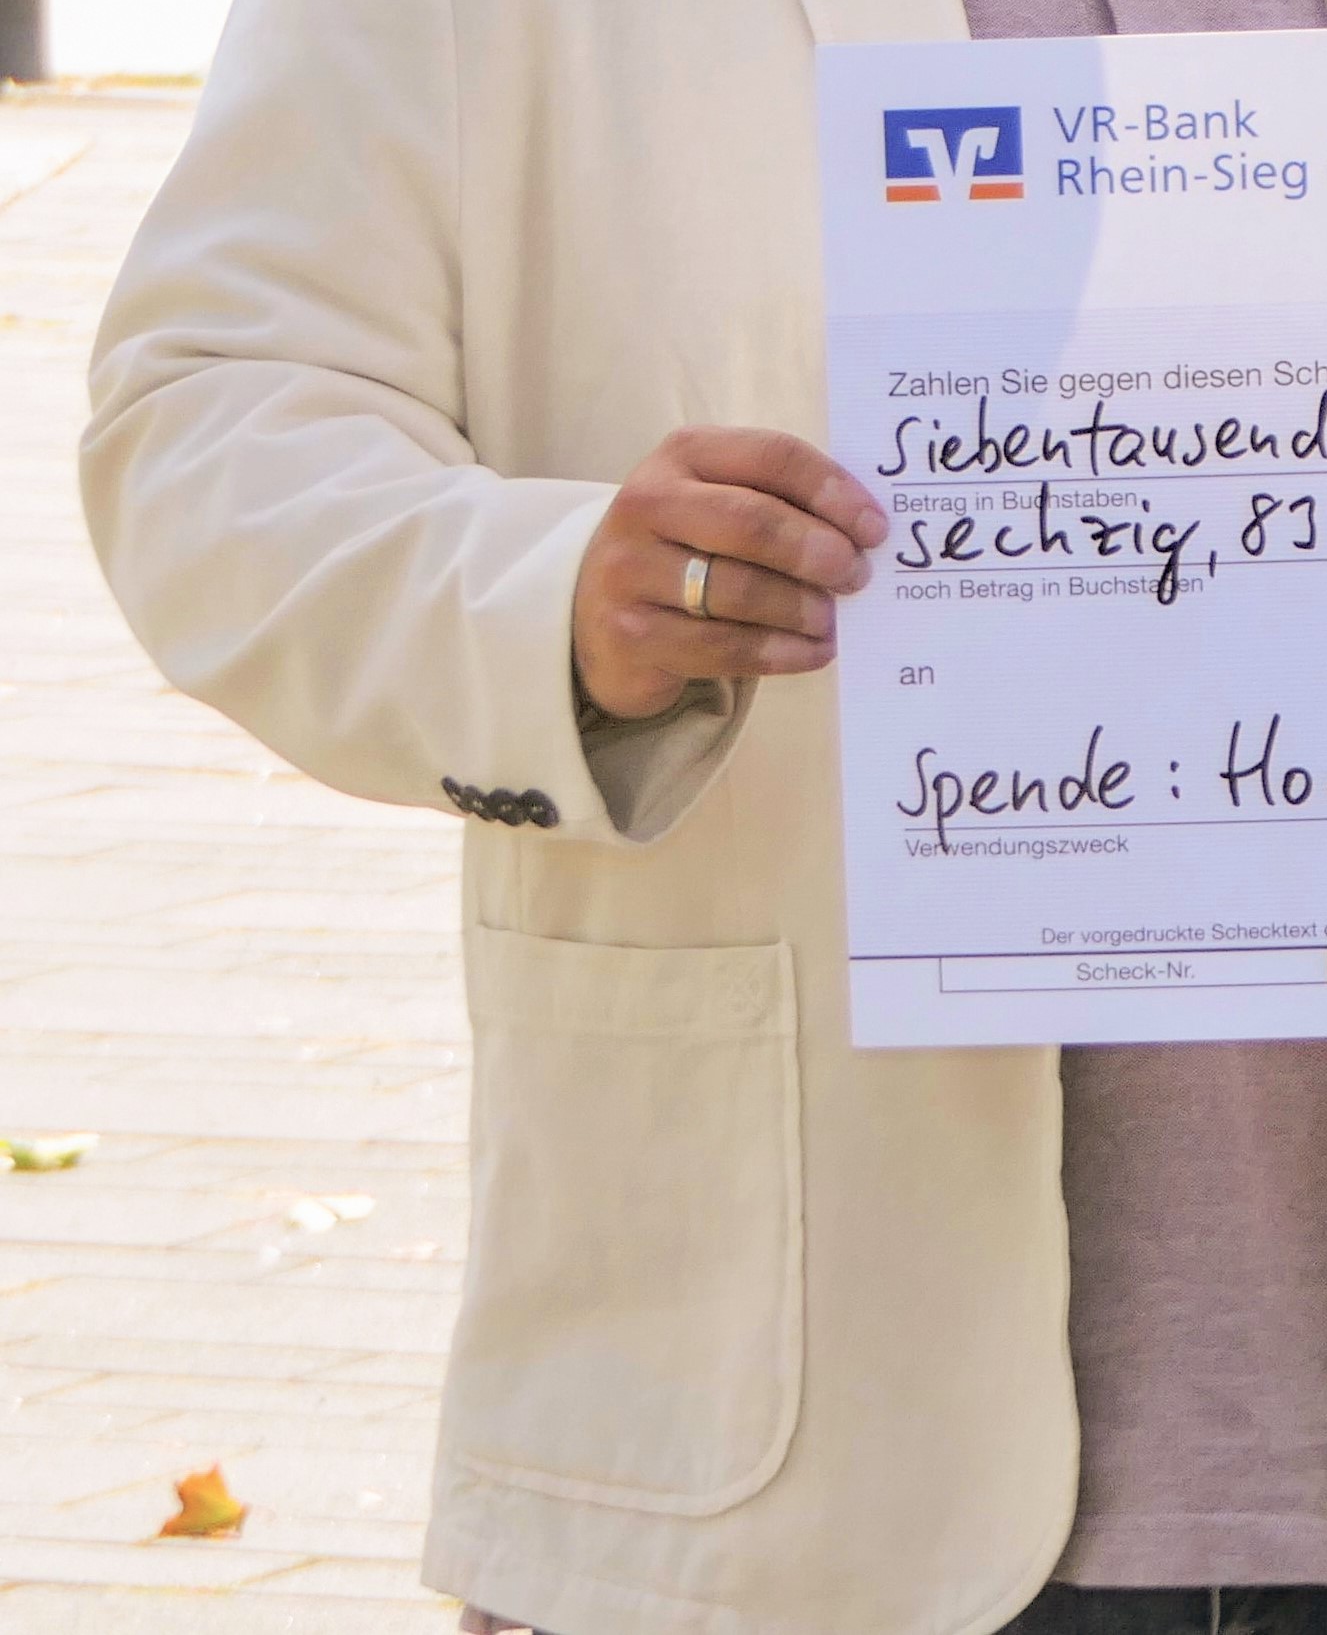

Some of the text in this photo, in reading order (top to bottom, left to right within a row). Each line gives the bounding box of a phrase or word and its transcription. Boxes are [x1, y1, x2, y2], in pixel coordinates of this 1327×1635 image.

[1053, 100, 1259, 143] VR-Bank
[1057, 153, 1308, 200] Rhein-Sieg
[888, 370, 990, 397] Zahlen
[1001, 368, 1049, 394] Sie
[1059, 370, 1152, 399] gegen
[1163, 364, 1262, 391] diesen
[892, 493, 967, 515] Betrag
[975, 492, 995, 512] in
[1241, 492, 1318, 557] 83
[896, 579, 952, 601] noch
[959, 578, 1034, 602] Betrag
[1043, 577, 1061, 597] in
[899, 664, 936, 686] an
[904, 835, 1129, 862] Verwendungszweck
[1041, 927, 1073, 945] Der
[1080, 926, 1205, 946] vorgedruckte
[1211, 922, 1318, 941] Schecktext
[1075, 961, 1196, 982] Scheck-Nr.
